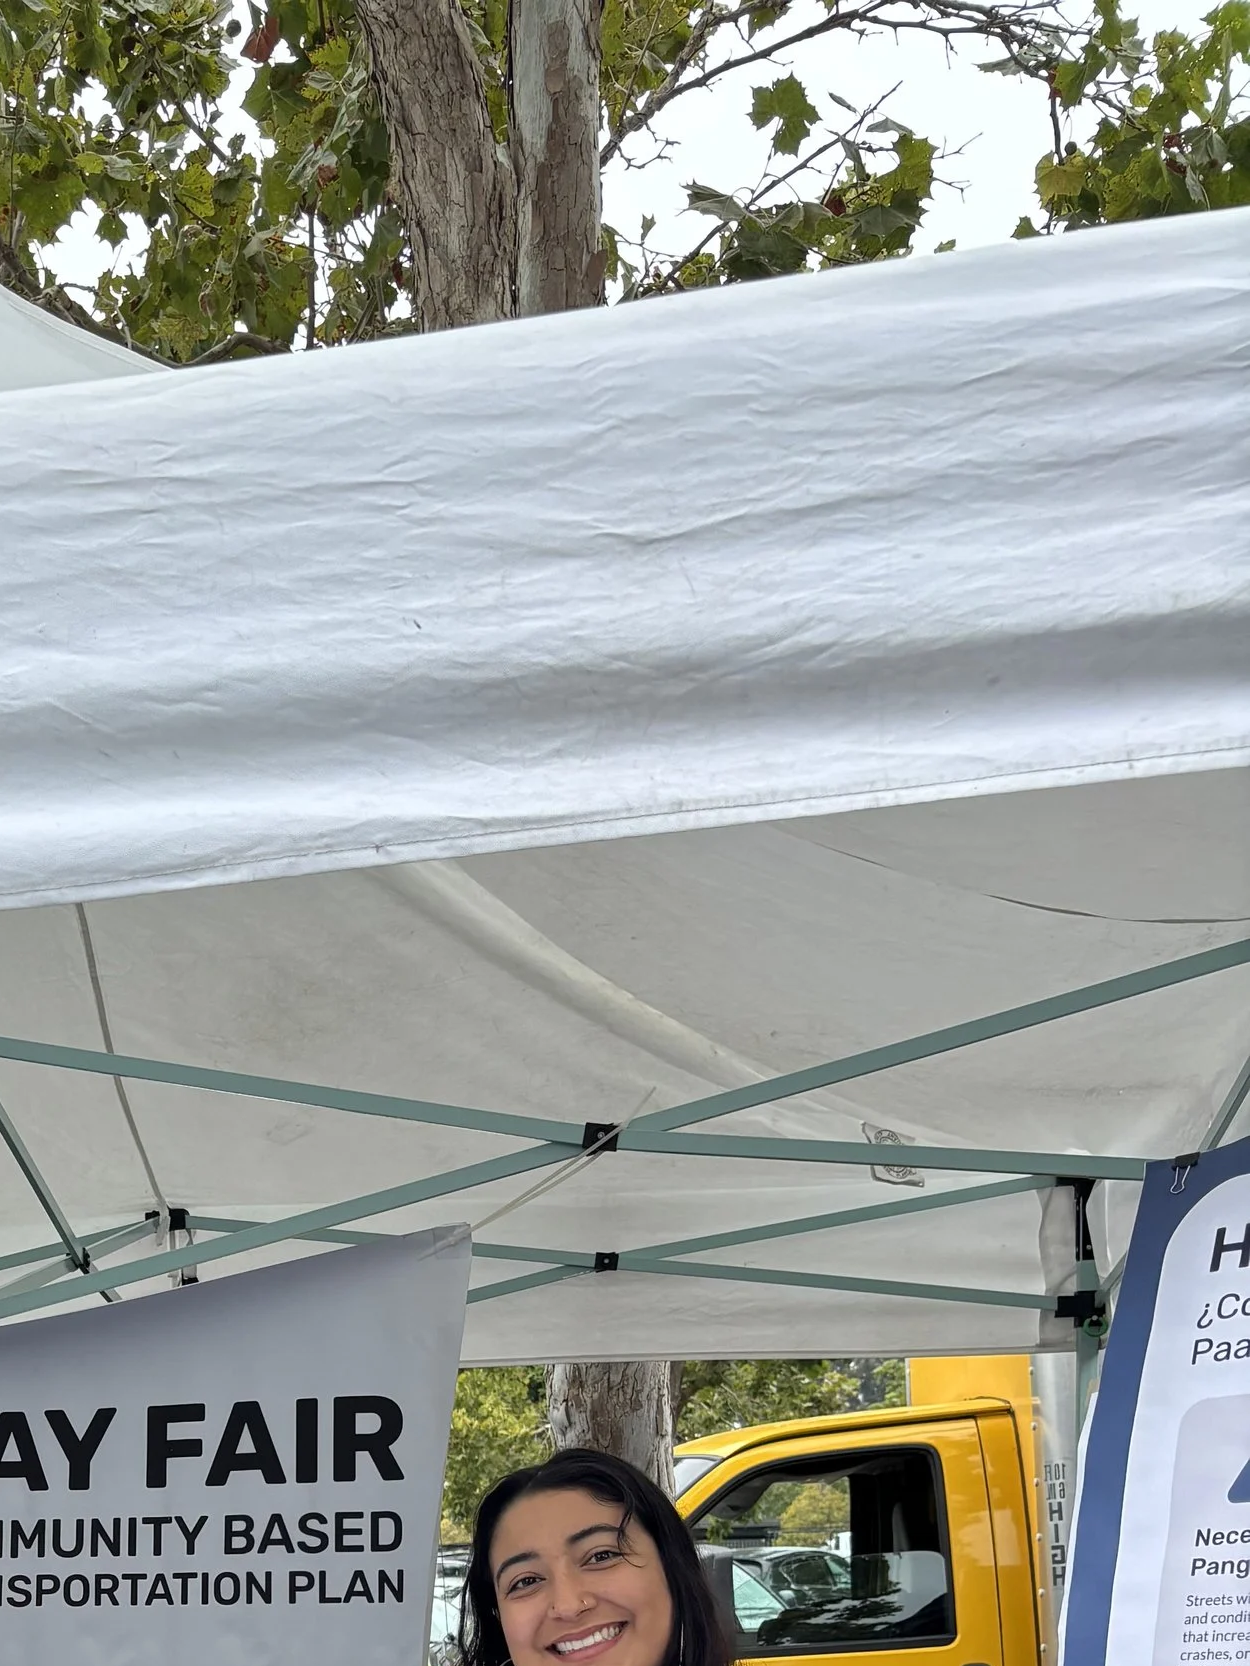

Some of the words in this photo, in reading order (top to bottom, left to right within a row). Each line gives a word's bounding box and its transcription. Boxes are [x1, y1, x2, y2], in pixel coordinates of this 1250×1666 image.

[146, 1395, 405, 1488] FAIR
[223, 1511, 403, 1555] BASED
[287, 1569, 405, 1604] PLAN
[1186, 1594, 1233, 1607] Streets
[1184, 1612, 1208, 1625] and
[1182, 1631, 1209, 1643] that
[1180, 1649, 1233, 1662] crashes,
